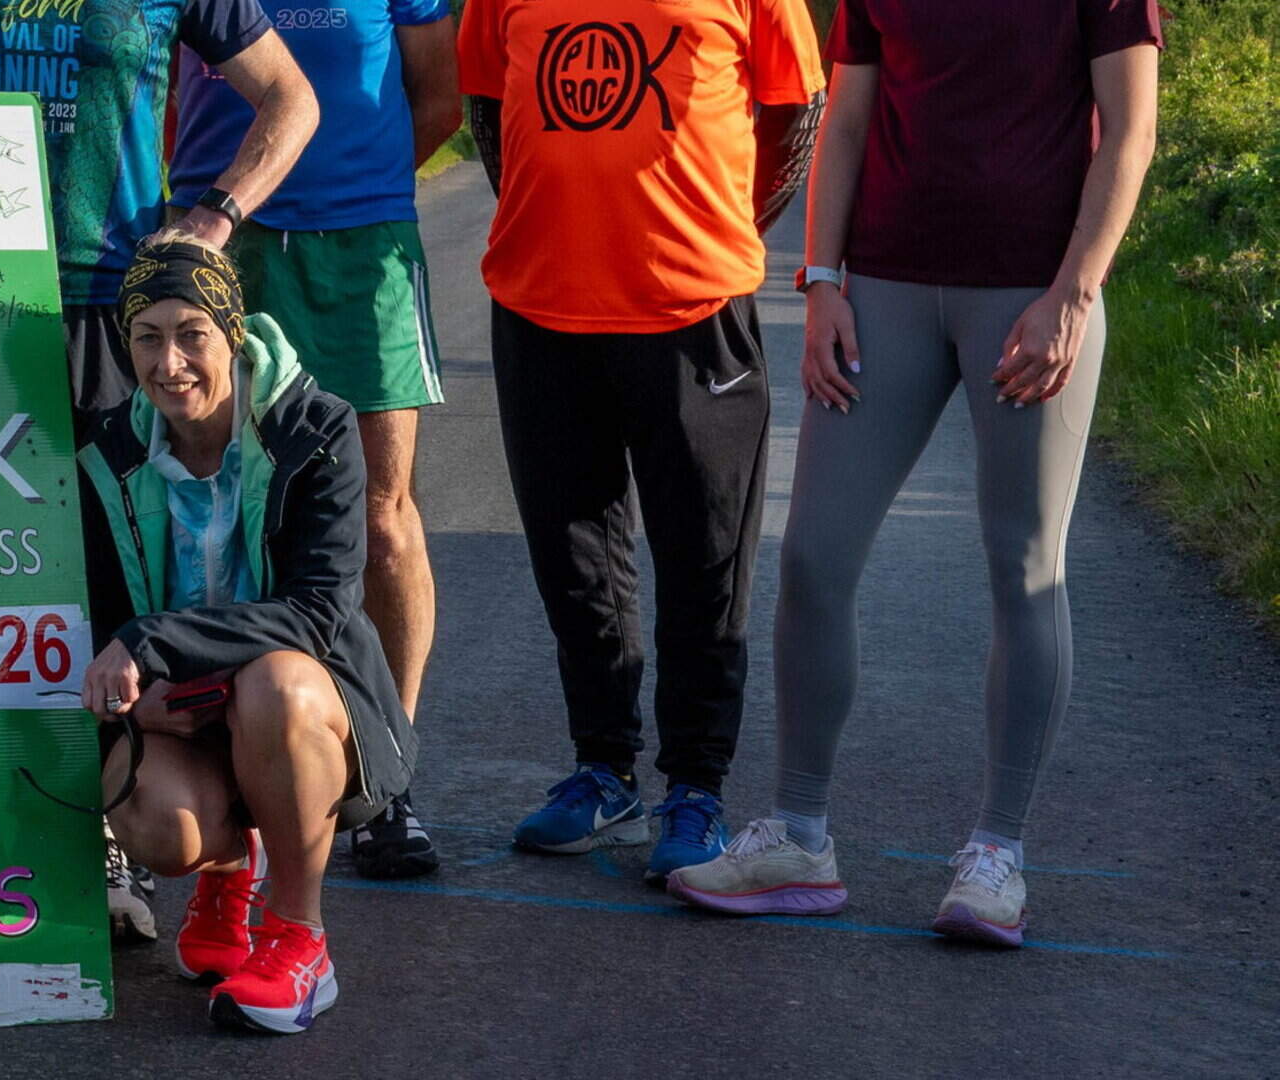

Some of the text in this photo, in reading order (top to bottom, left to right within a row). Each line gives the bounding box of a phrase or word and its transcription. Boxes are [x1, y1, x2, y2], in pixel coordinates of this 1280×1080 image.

[276, 8, 348, 29] 2025
[53, 24, 81, 53] OF
[49, 103, 77, 118] 2023
